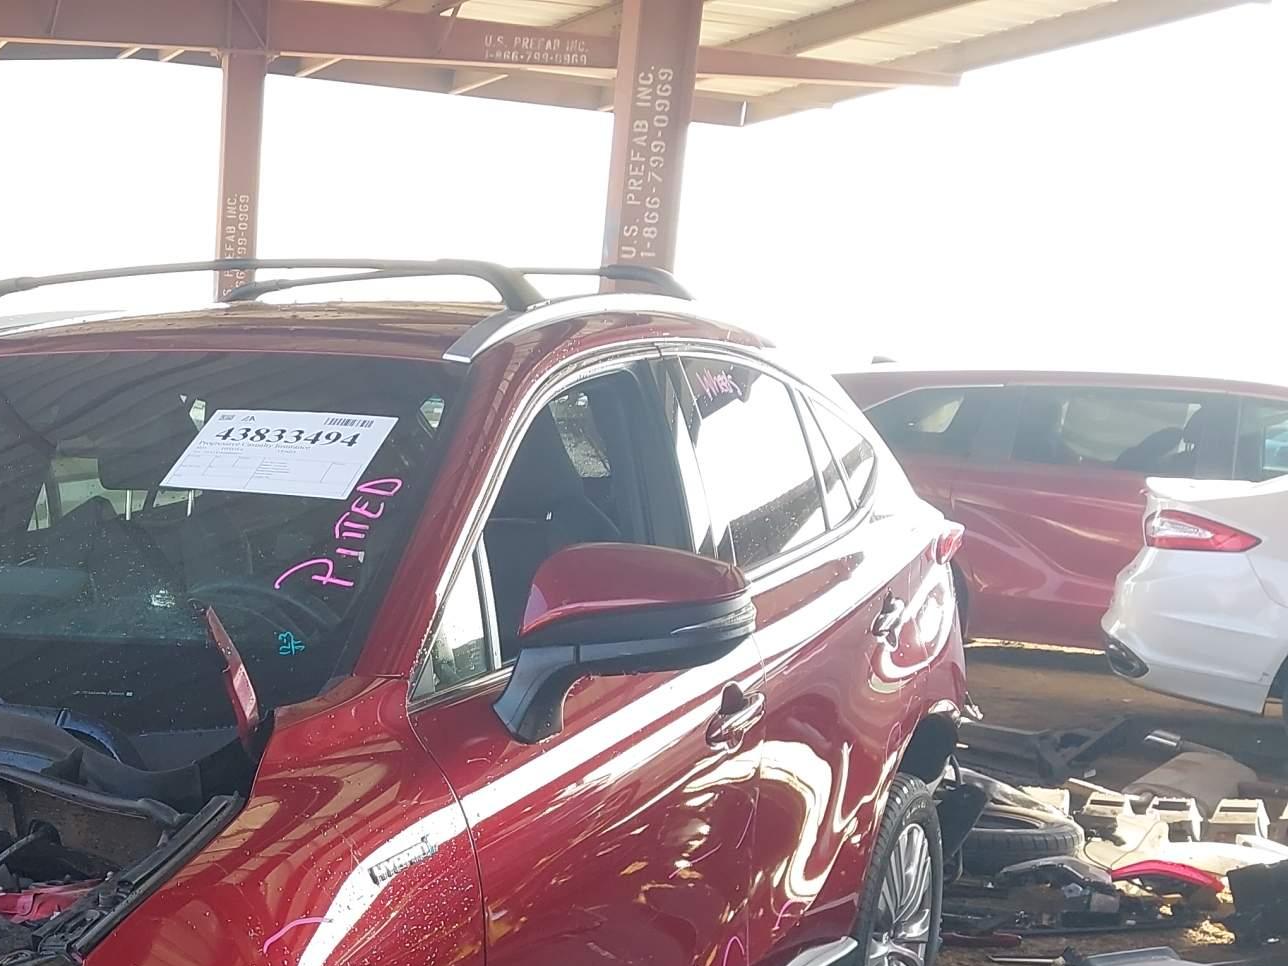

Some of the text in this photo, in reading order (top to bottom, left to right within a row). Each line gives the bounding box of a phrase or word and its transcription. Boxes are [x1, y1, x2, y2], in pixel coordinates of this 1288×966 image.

[513, 37, 560, 50] PREFAB
[621, 65, 655, 258] U.S. PREFAB INC.
[640, 68, 674, 258] 1-866-799-0969
[226, 193, 238, 219] INC.
[215, 426, 361, 447] 43833494
[274, 478, 402, 589] PITTED
